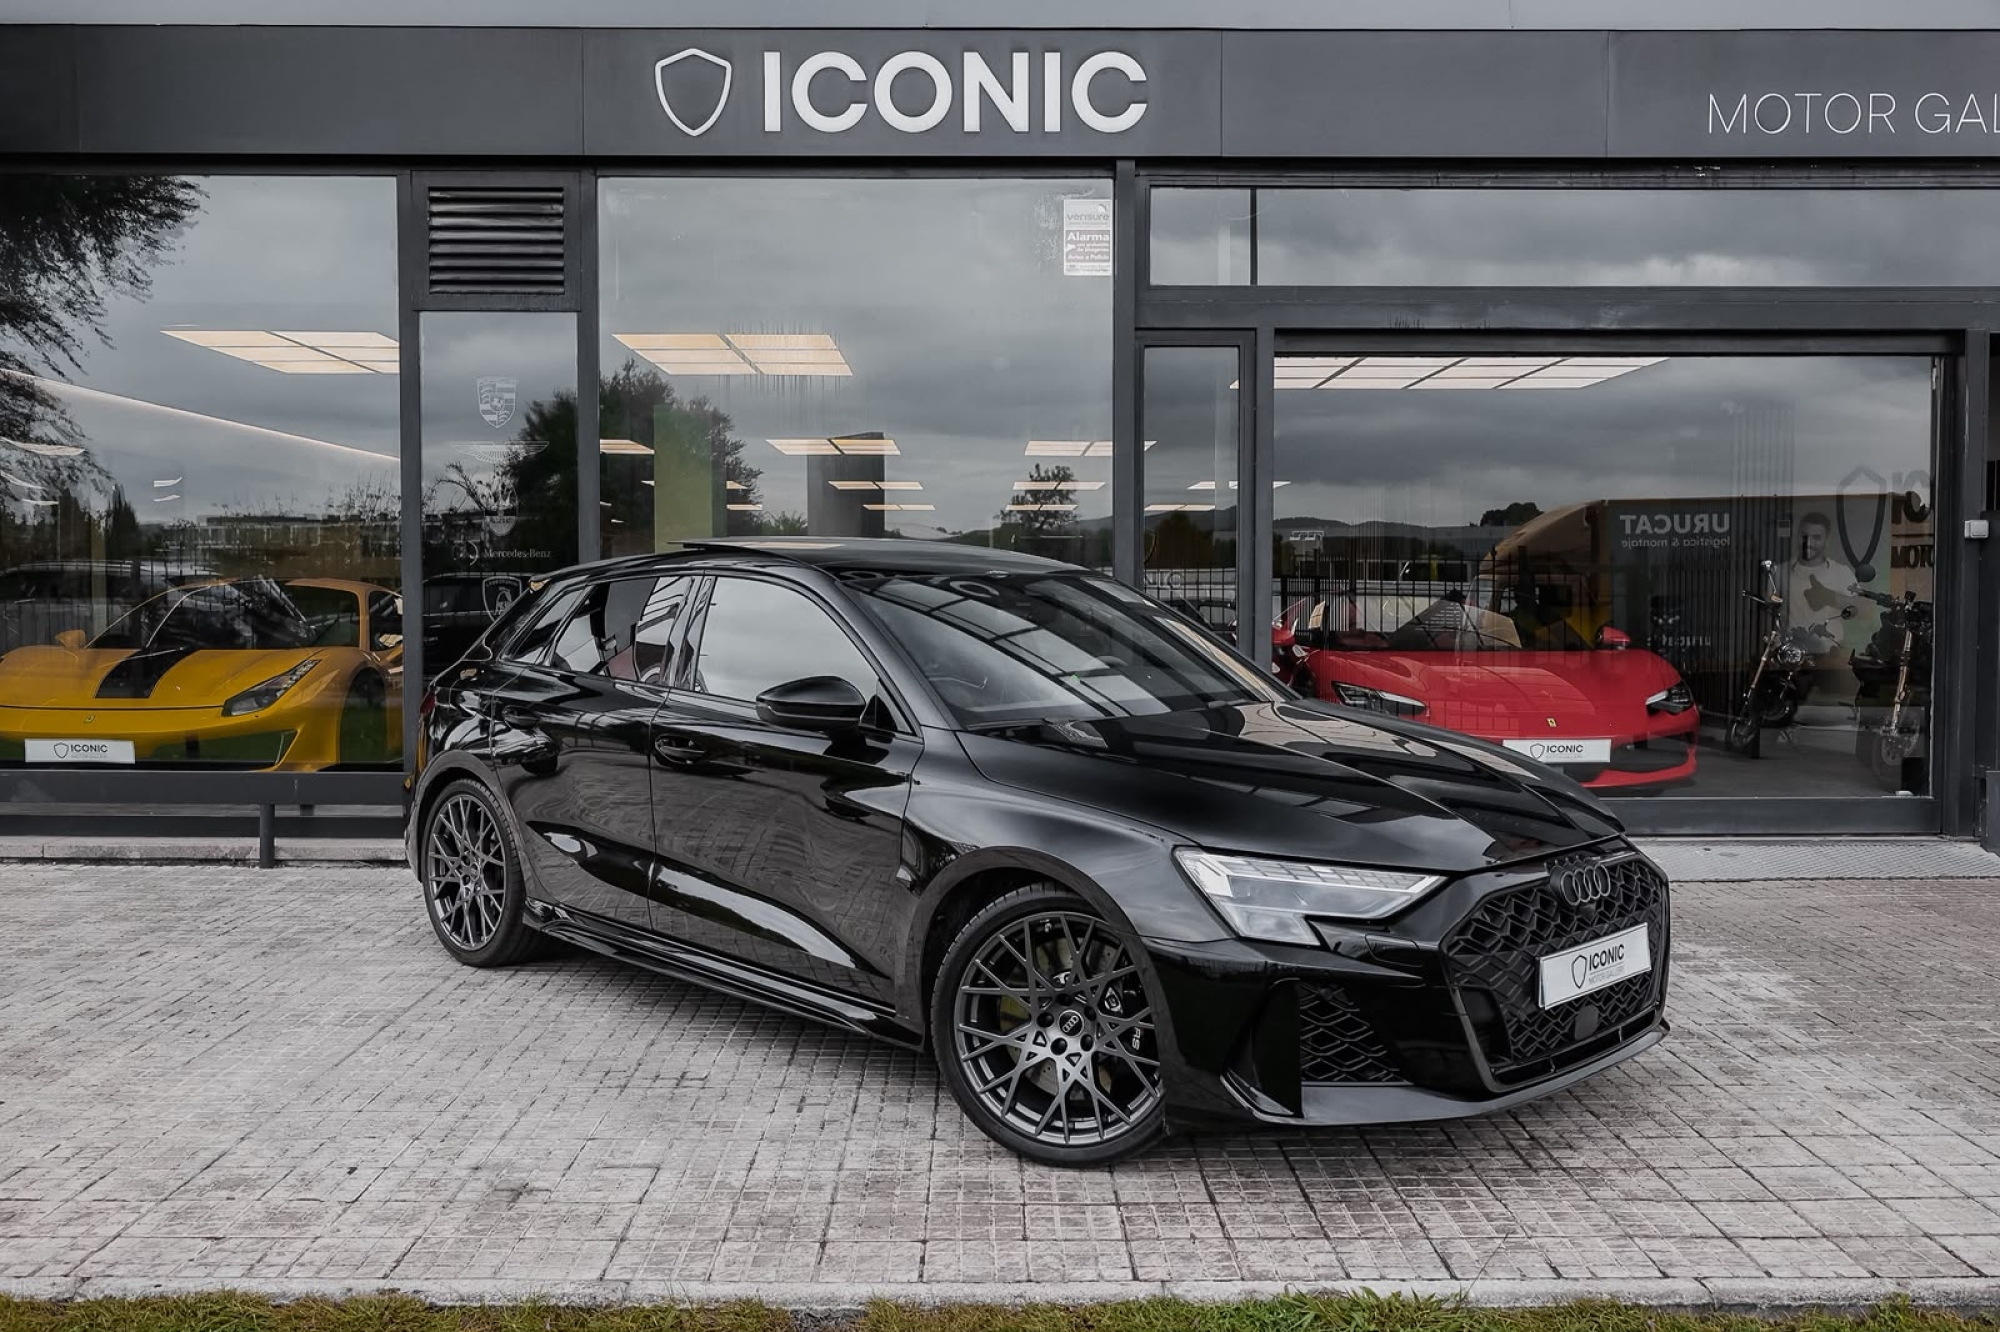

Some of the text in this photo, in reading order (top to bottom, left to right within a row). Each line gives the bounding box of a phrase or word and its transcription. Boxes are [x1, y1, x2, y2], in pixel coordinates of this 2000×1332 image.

[763, 50, 1148, 133] ICONIC
[1708, 93, 1897, 135] MOTOR
[1066, 213, 1110, 221] verisure
[1066, 231, 1110, 241] Alarma
[484, 548, 551, 558] Mercedes-Benz
[70, 744, 108, 753] ICONIC
[1546, 744, 1584, 753] ICONIC
[1589, 943, 1625, 972] ICONIC
[1132, 1026, 1141, 1051] RS
